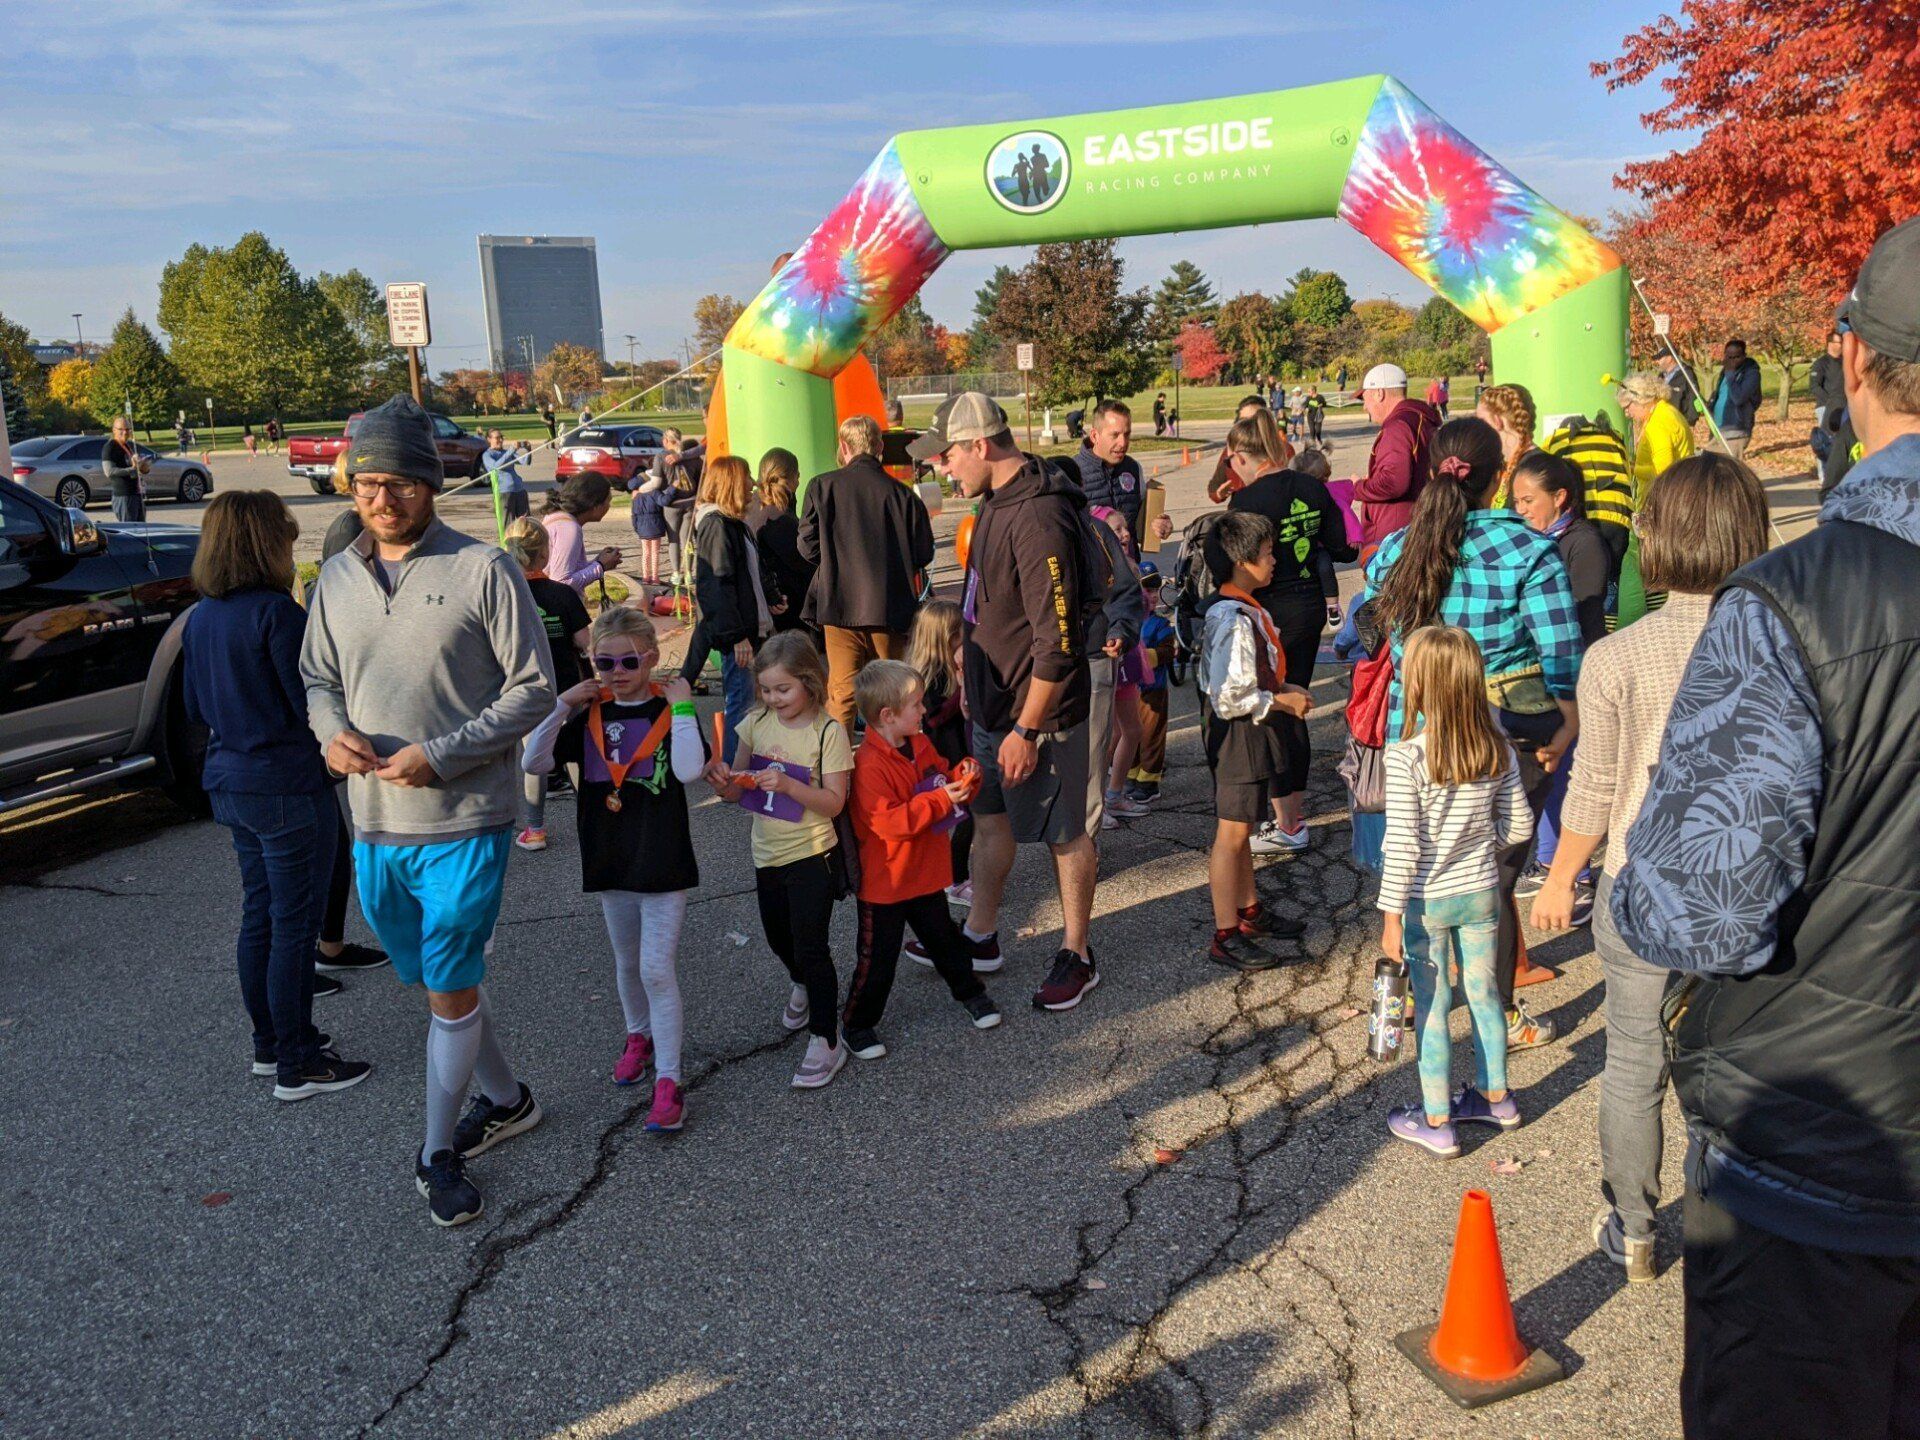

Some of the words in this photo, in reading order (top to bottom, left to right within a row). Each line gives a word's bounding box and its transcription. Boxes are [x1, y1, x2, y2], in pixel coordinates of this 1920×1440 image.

[1084, 117, 1273, 167] EASTSIDE
[1086, 175, 1160, 194] RACING
[1174, 164, 1272, 186] COMPANY
[1047, 557, 1063, 594] EASTER
[1055, 595, 1067, 617] JEEP
[84, 617, 134, 634] RAM
[763, 789, 775, 812] 1
